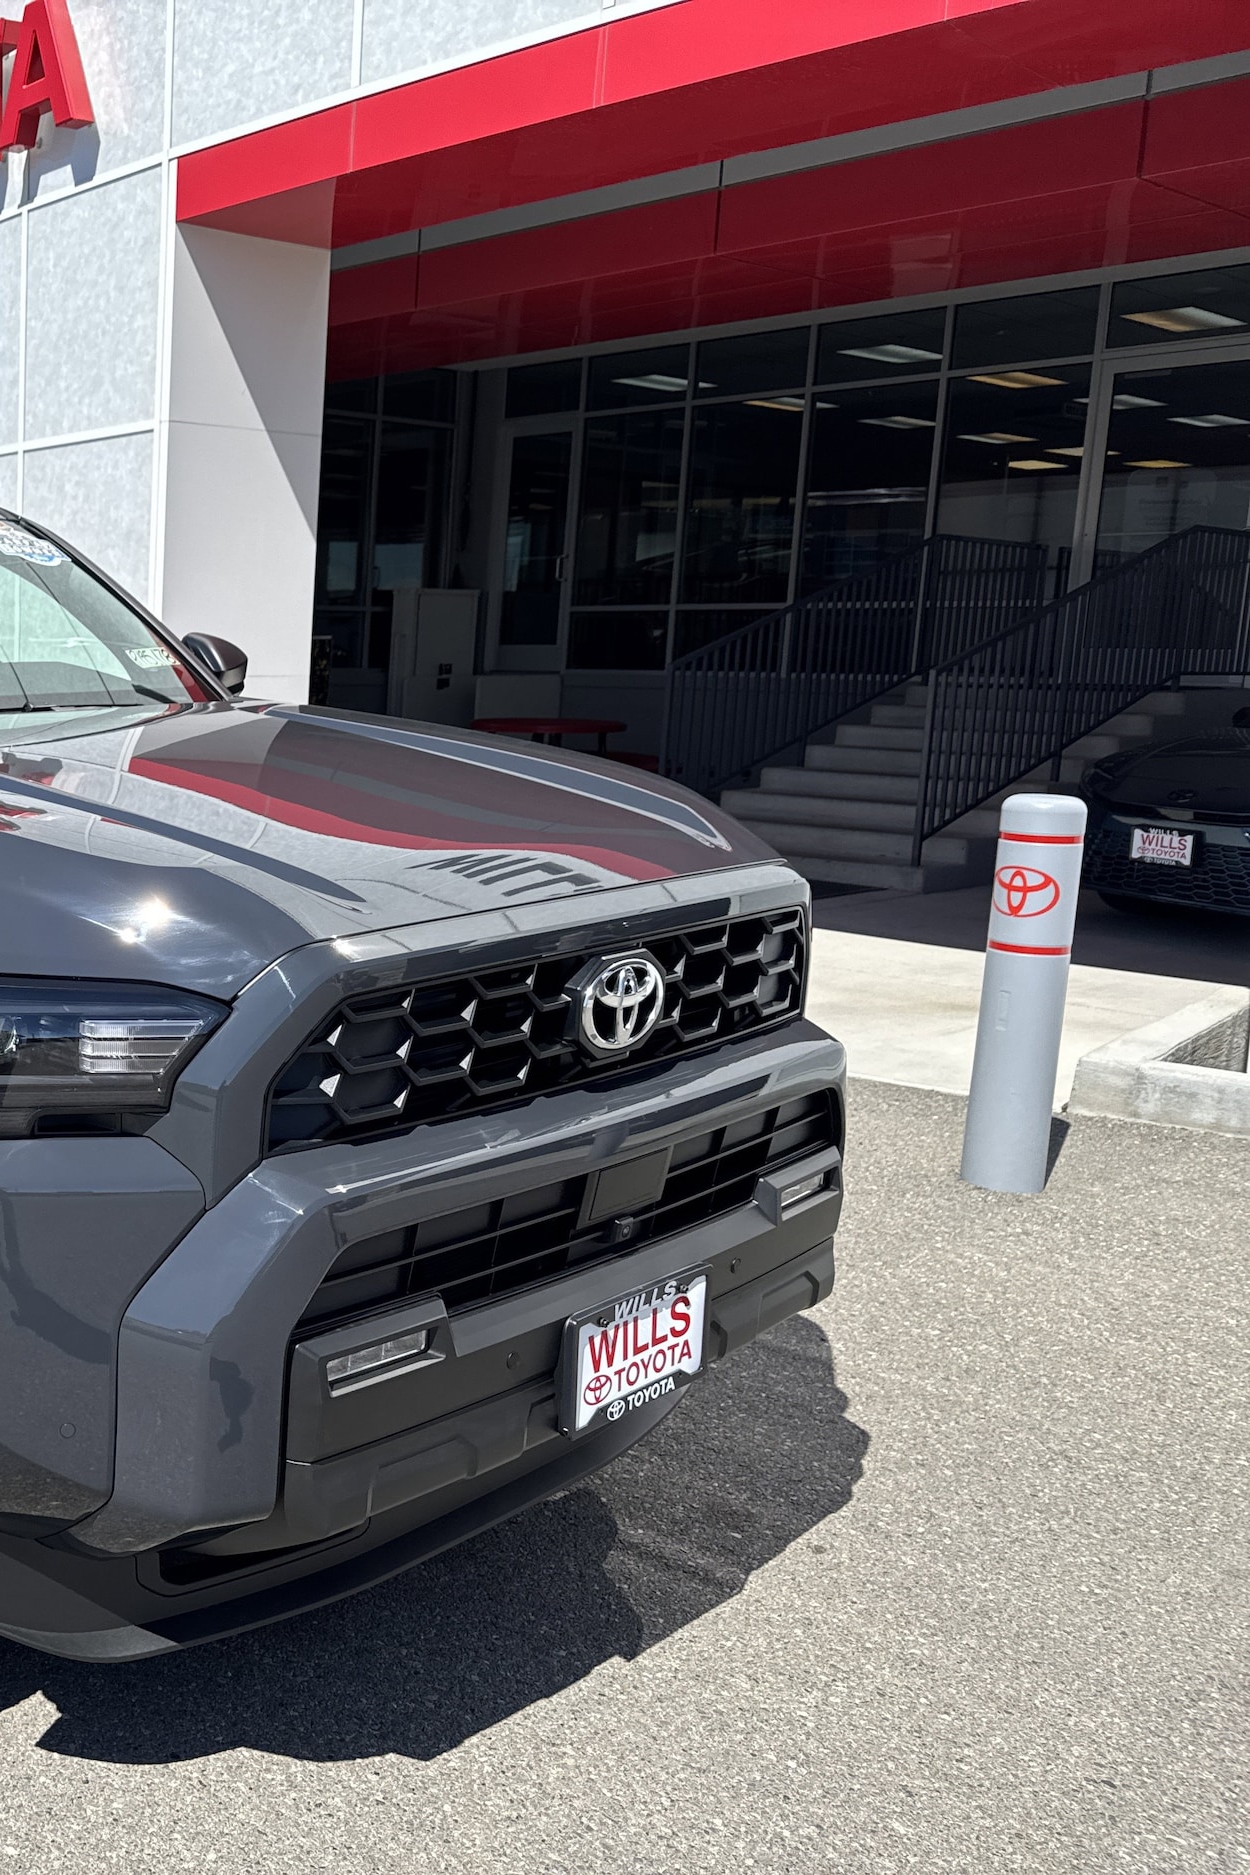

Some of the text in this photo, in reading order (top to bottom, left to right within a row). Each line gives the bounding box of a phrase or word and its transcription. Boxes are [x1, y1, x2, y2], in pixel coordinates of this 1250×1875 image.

[1141, 834, 1187, 851] WILLS
[1151, 848, 1186, 860] TOYOTA
[614, 1281, 678, 1321] WILLS
[588, 1295, 691, 1373] WILLS
[614, 1339, 692, 1392] TOYOTA
[626, 1376, 676, 1411] TOYOTA
